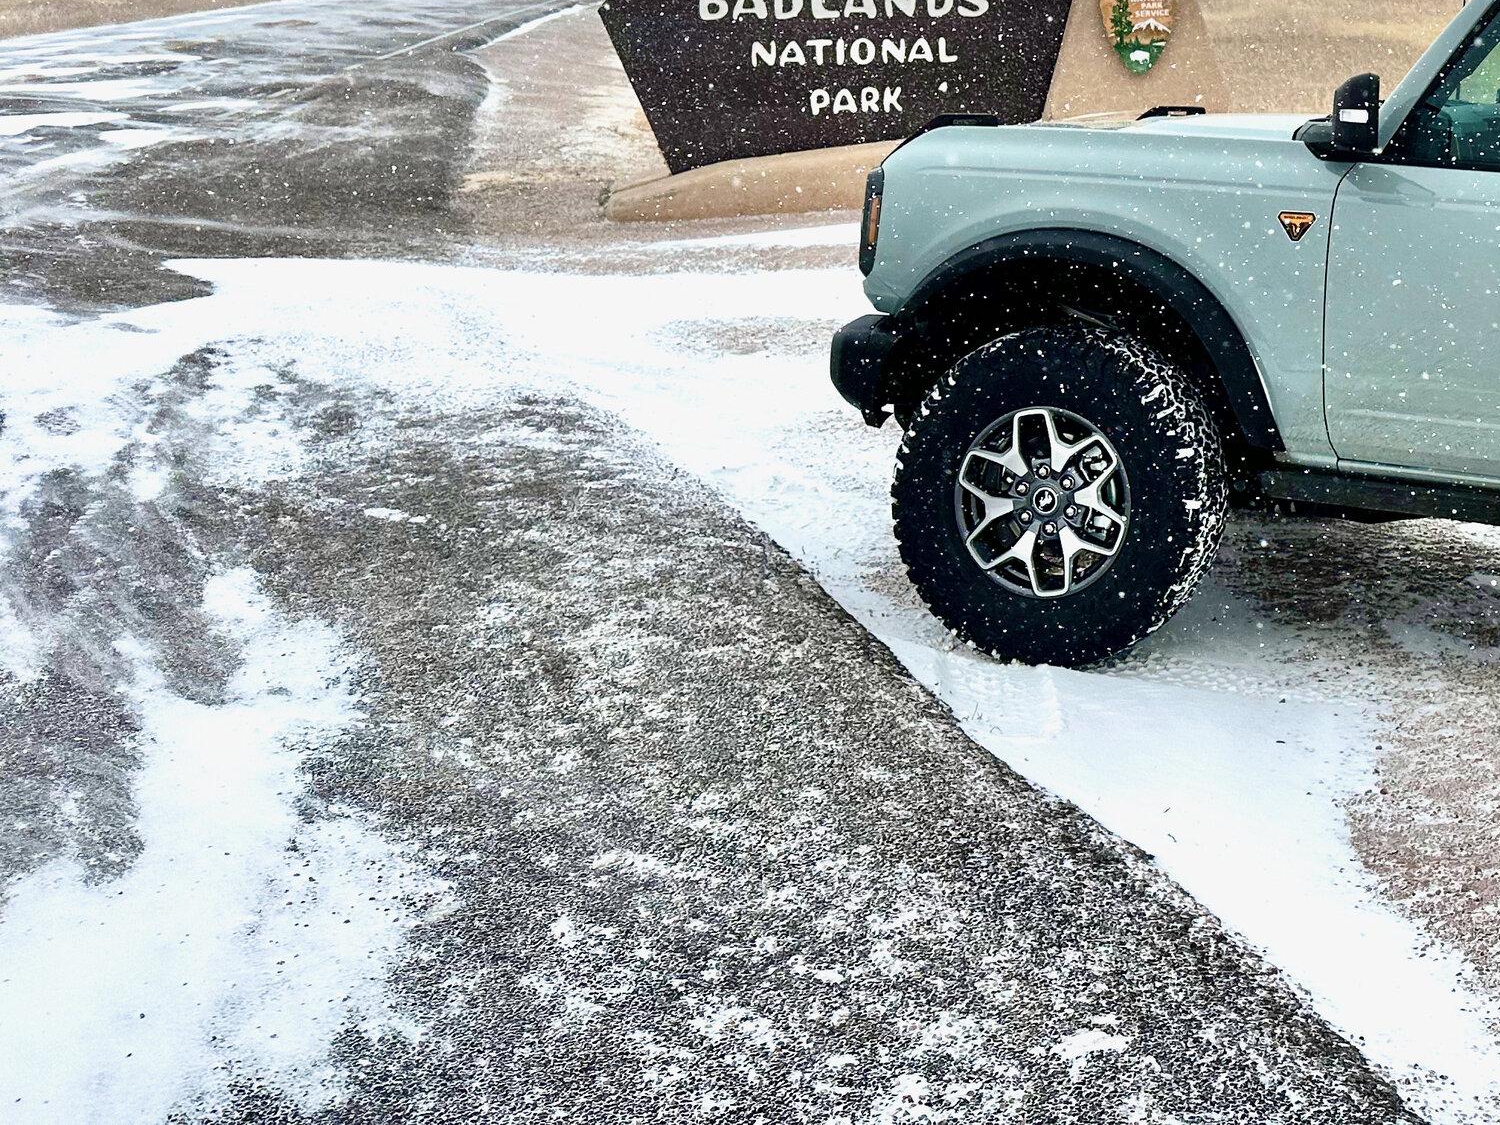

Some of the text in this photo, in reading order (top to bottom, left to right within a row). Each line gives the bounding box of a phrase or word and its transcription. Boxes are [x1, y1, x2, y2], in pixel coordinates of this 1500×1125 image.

[1135, 9, 1169, 17] SERVICE
[751, 36, 959, 68] NATIONAL
[809, 86, 903, 116] PARK
